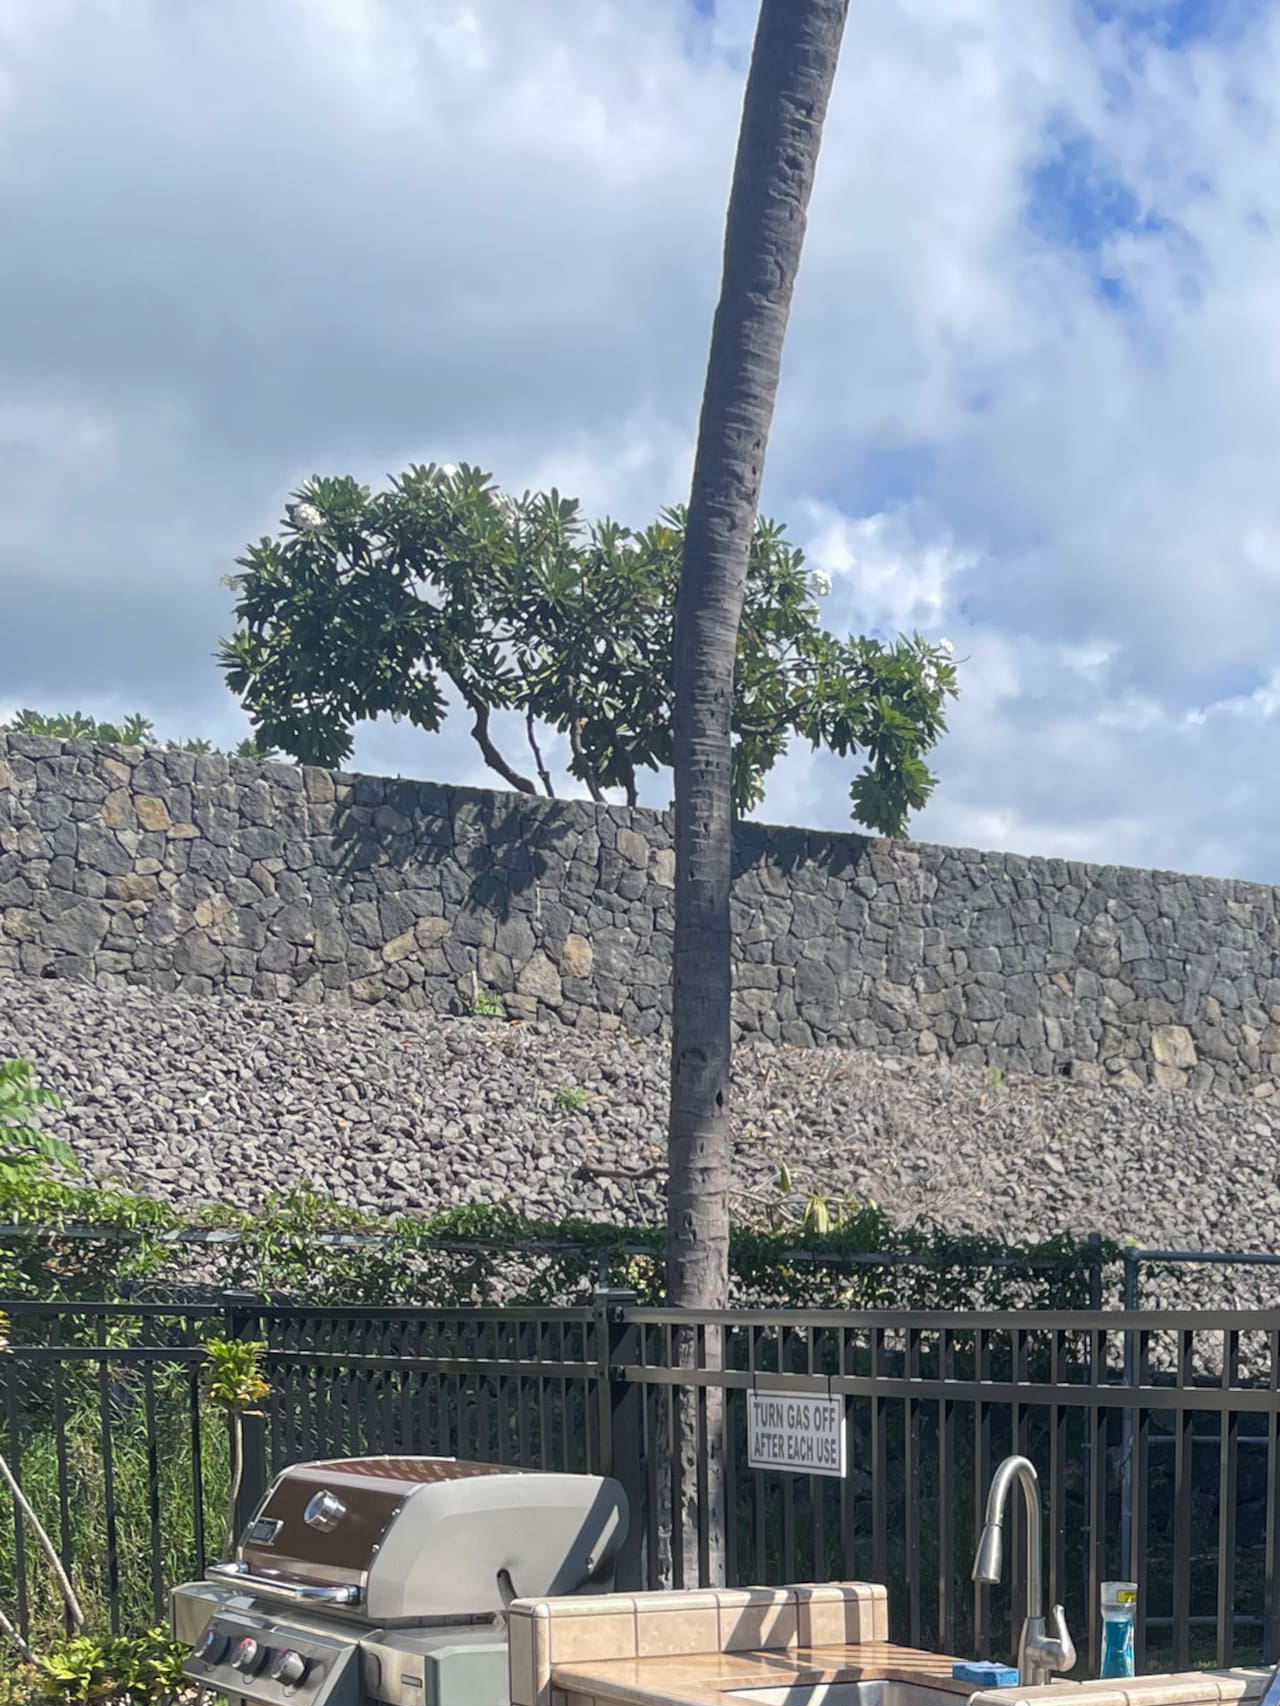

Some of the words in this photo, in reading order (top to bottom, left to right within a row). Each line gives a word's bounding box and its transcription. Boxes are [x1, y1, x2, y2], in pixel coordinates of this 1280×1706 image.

[753, 1402, 783, 1428] TURN
[787, 1404, 810, 1430] GAS
[814, 1406, 836, 1433] OFF
[754, 1432, 785, 1459] AFTER
[787, 1435, 814, 1461] EACH
[816, 1437, 837, 1465] USE
